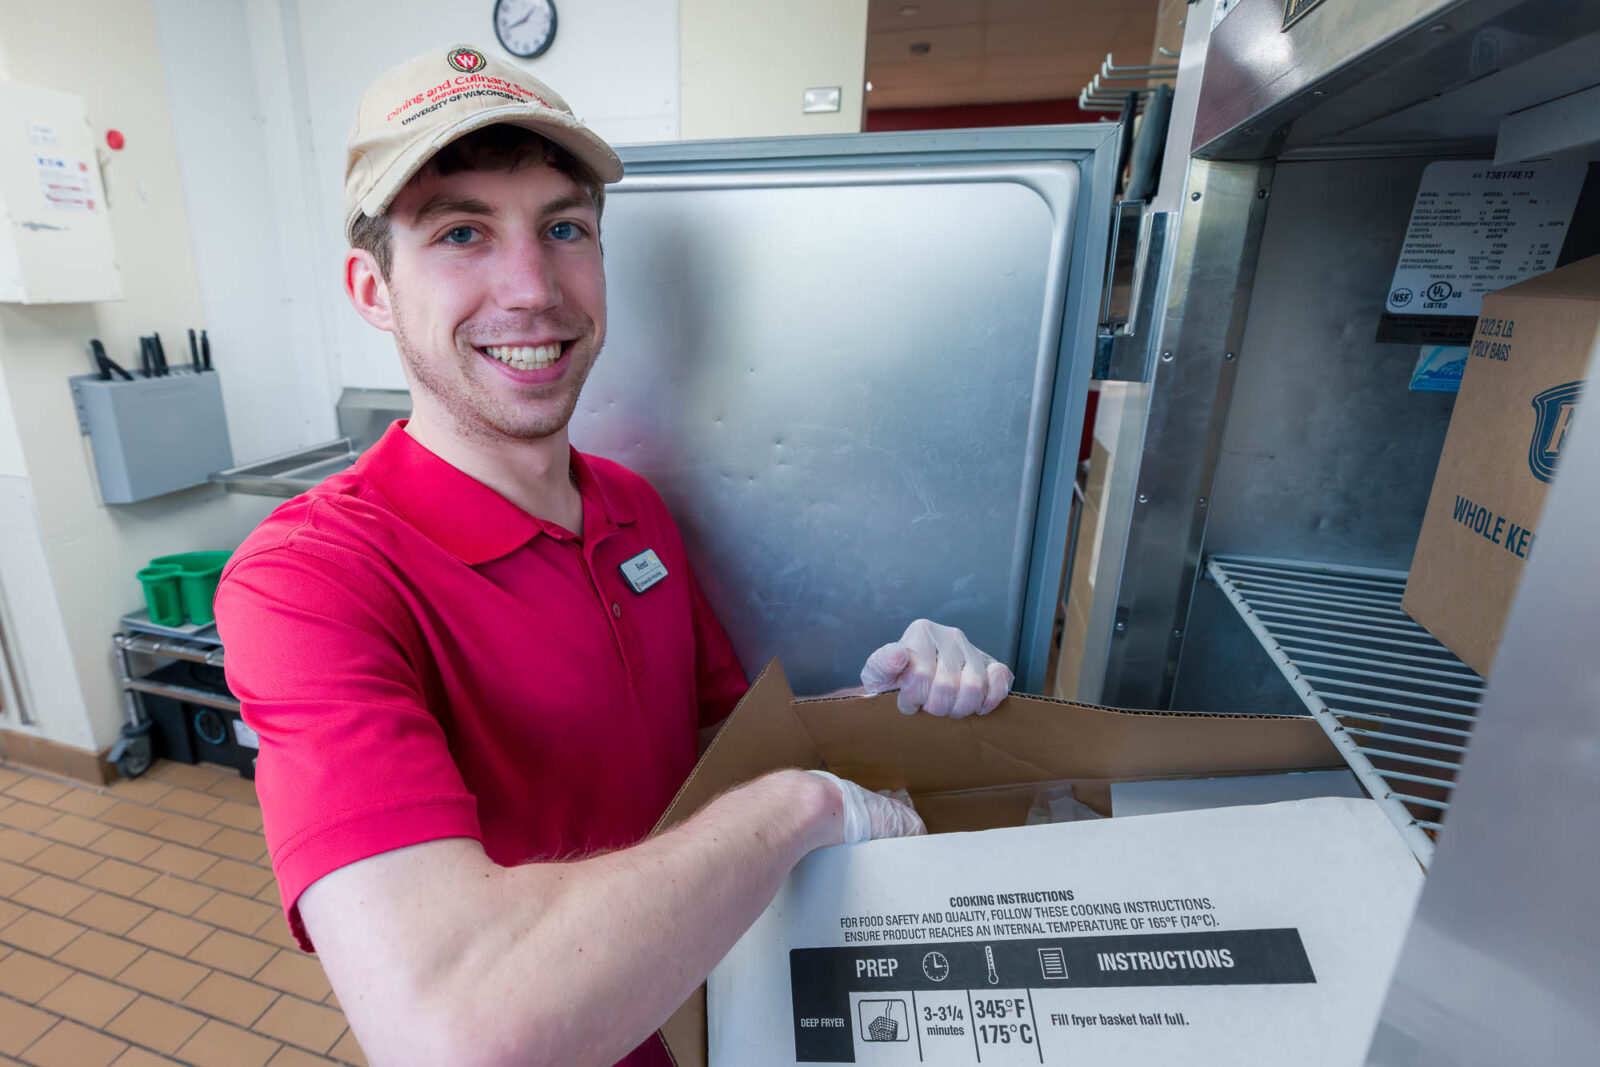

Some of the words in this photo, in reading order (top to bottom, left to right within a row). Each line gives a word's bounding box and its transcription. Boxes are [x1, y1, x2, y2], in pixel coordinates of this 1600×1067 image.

[456, 54, 476, 68] W
[387, 93, 424, 121] Dining
[426, 80, 451, 98] and
[454, 74, 511, 89] Culinary
[431, 84, 481, 103] UNIVERSITY
[483, 84, 523, 98] HOUSING
[402, 99, 448, 126] UNIVERSITY
[449, 94, 463, 102] OF
[1392, 292, 1411, 302] NSF
[1479, 318, 1503, 337] 12/2.5
[1471, 340, 1491, 358] POLY
[1489, 342, 1512, 362] BAGS
[1453, 495, 1506, 545] WHOLE
[949, 895, 995, 908] COOKING
[997, 890, 1075, 905] INSTRUCTIONS
[840, 917, 858, 929] FOR
[859, 916, 884, 928] FOOD
[885, 914, 920, 926] SAFETY
[921, 912, 943, 924] AND
[945, 910, 990, 923] QUALITY,
[991, 907, 1032, 920] FOLLOW
[1034, 905, 1070, 919] THESE
[1070, 902, 1122, 917] COOKING
[1123, 897, 1216, 914] INSTRUCTIONS.
[845, 930, 881, 942] ENSURE
[883, 928, 927, 941] PRODUCT
[928, 926, 974, 939] REACHES
[976, 924, 992, 937] AN
[993, 922, 1047, 936] INTERNAL
[1046, 918, 1128, 934] TEMPERATURE
[1130, 917, 1146, 930] OF
[855, 958, 899, 978] PREP
[1096, 948, 1235, 971] INSTRUCTIONS
[801, 1018, 820, 1028] DEEP
[820, 1018, 845, 1028] FRYER
[1050, 1013, 1070, 1026] Fill
[1071, 1013, 1098, 1028] fryer
[1099, 1013, 1138, 1026] basket
[1139, 1013, 1163, 1026] half
[1164, 1012, 1190, 1026] full.
[926, 1025, 965, 1036] minutes
